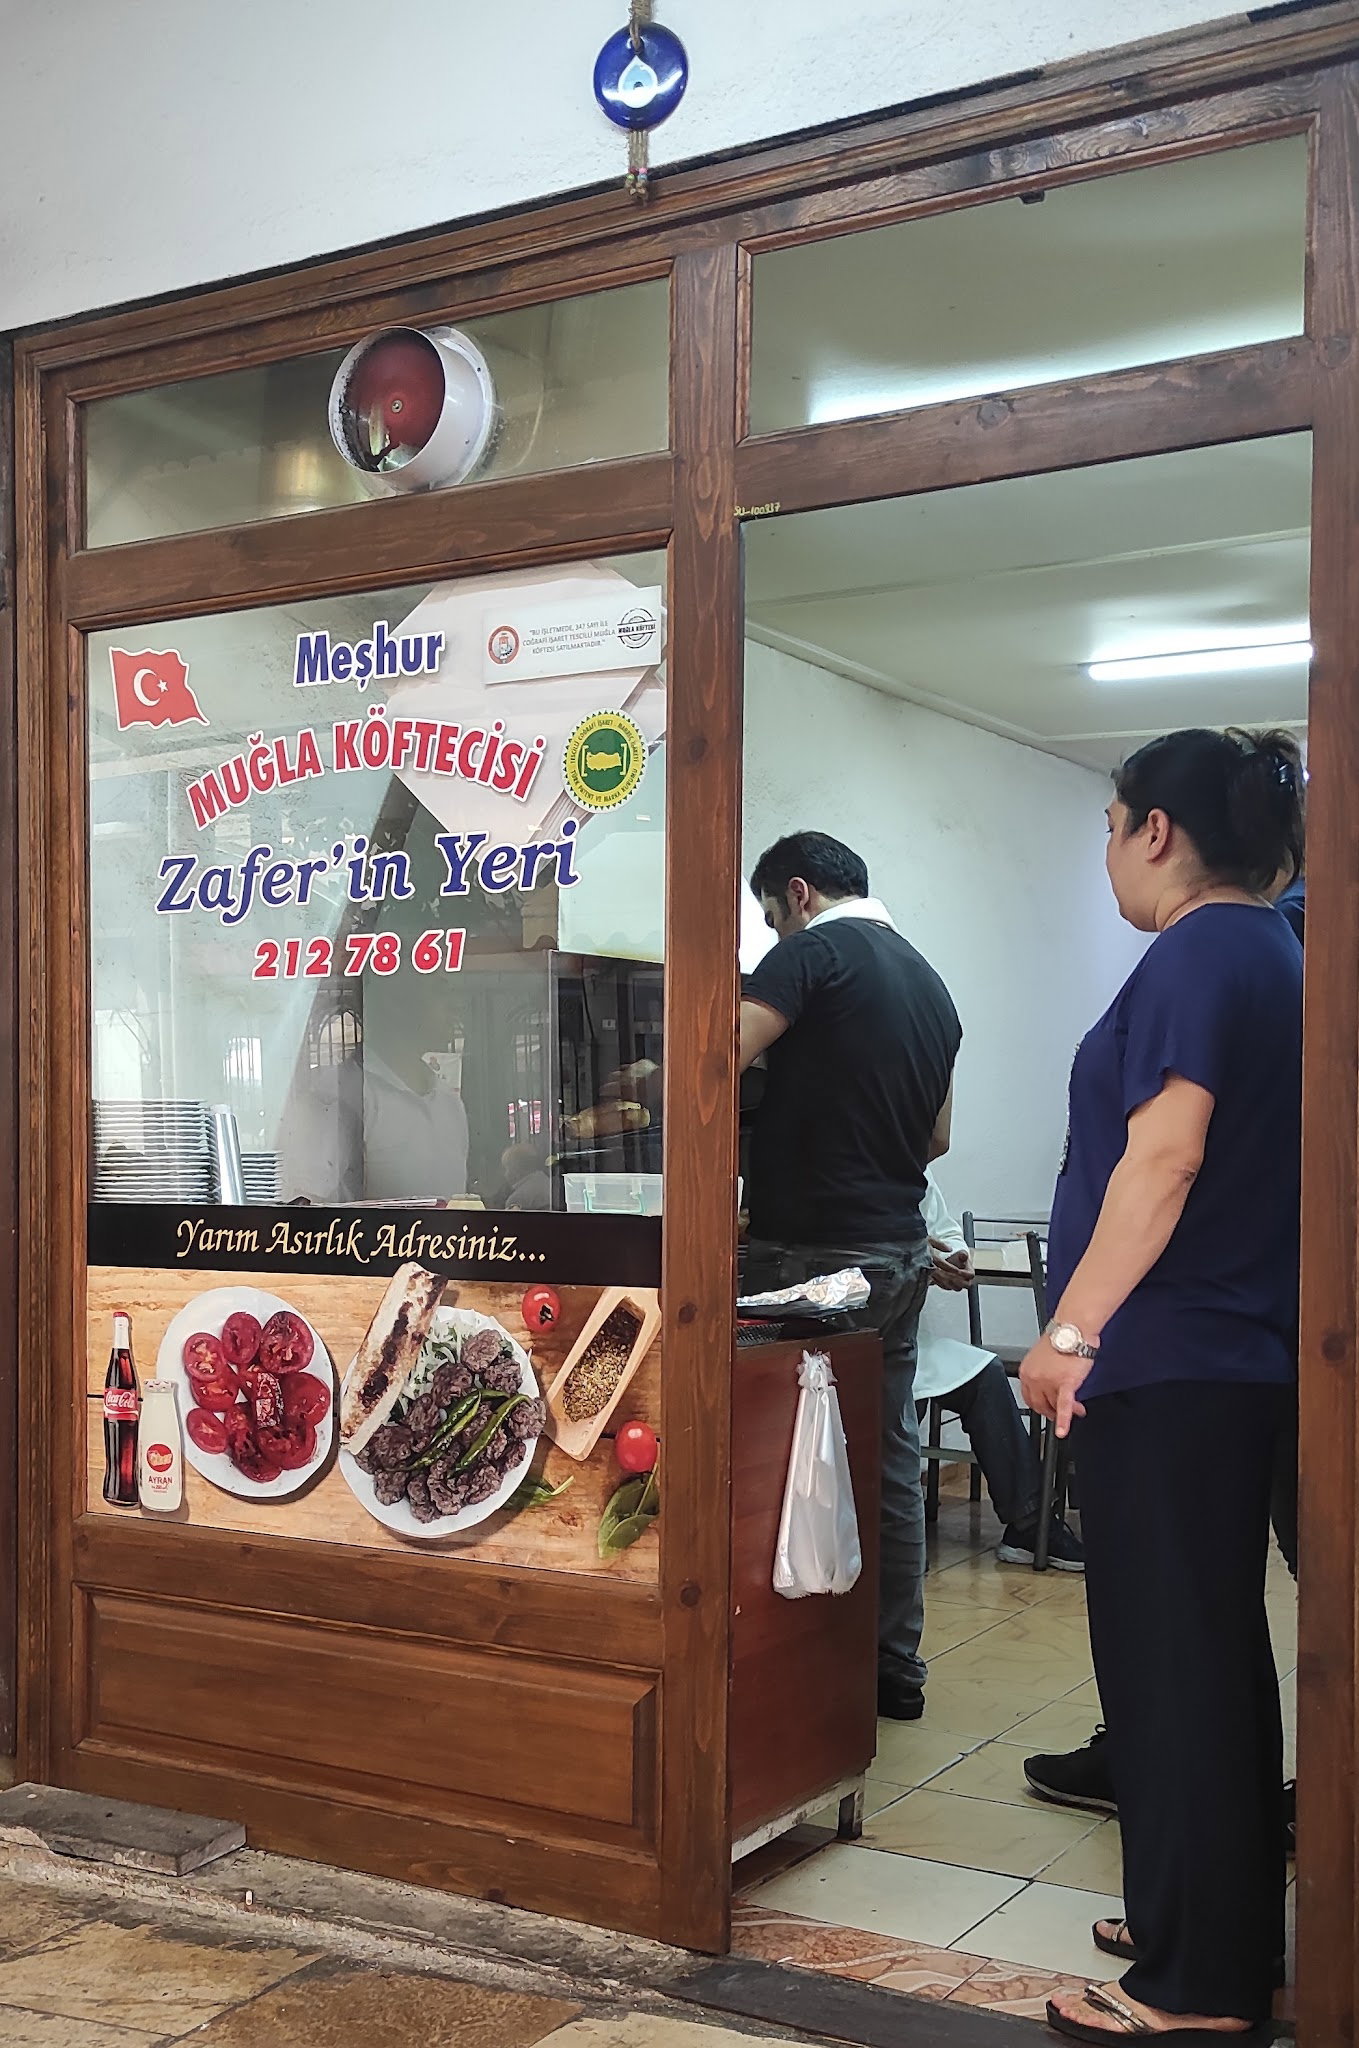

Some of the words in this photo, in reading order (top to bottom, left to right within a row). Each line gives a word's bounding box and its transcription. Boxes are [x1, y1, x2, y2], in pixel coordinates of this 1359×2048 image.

[295, 622, 444, 691] Meşhur
[186, 730, 324, 829] MUĞLA
[334, 705, 545, 801] KÖFTECİSİ
[436, 819, 580, 896] Yeri
[253, 939, 332, 979] 212
[346, 933, 400, 975] 78
[412, 929, 466, 973] 61
[176, 1218, 259, 1259] Yarım
[265, 1218, 369, 1263] Asırlık
[370, 1221, 547, 1262] Adresiniz...
[148, 1475, 173, 1484] AYRAN
